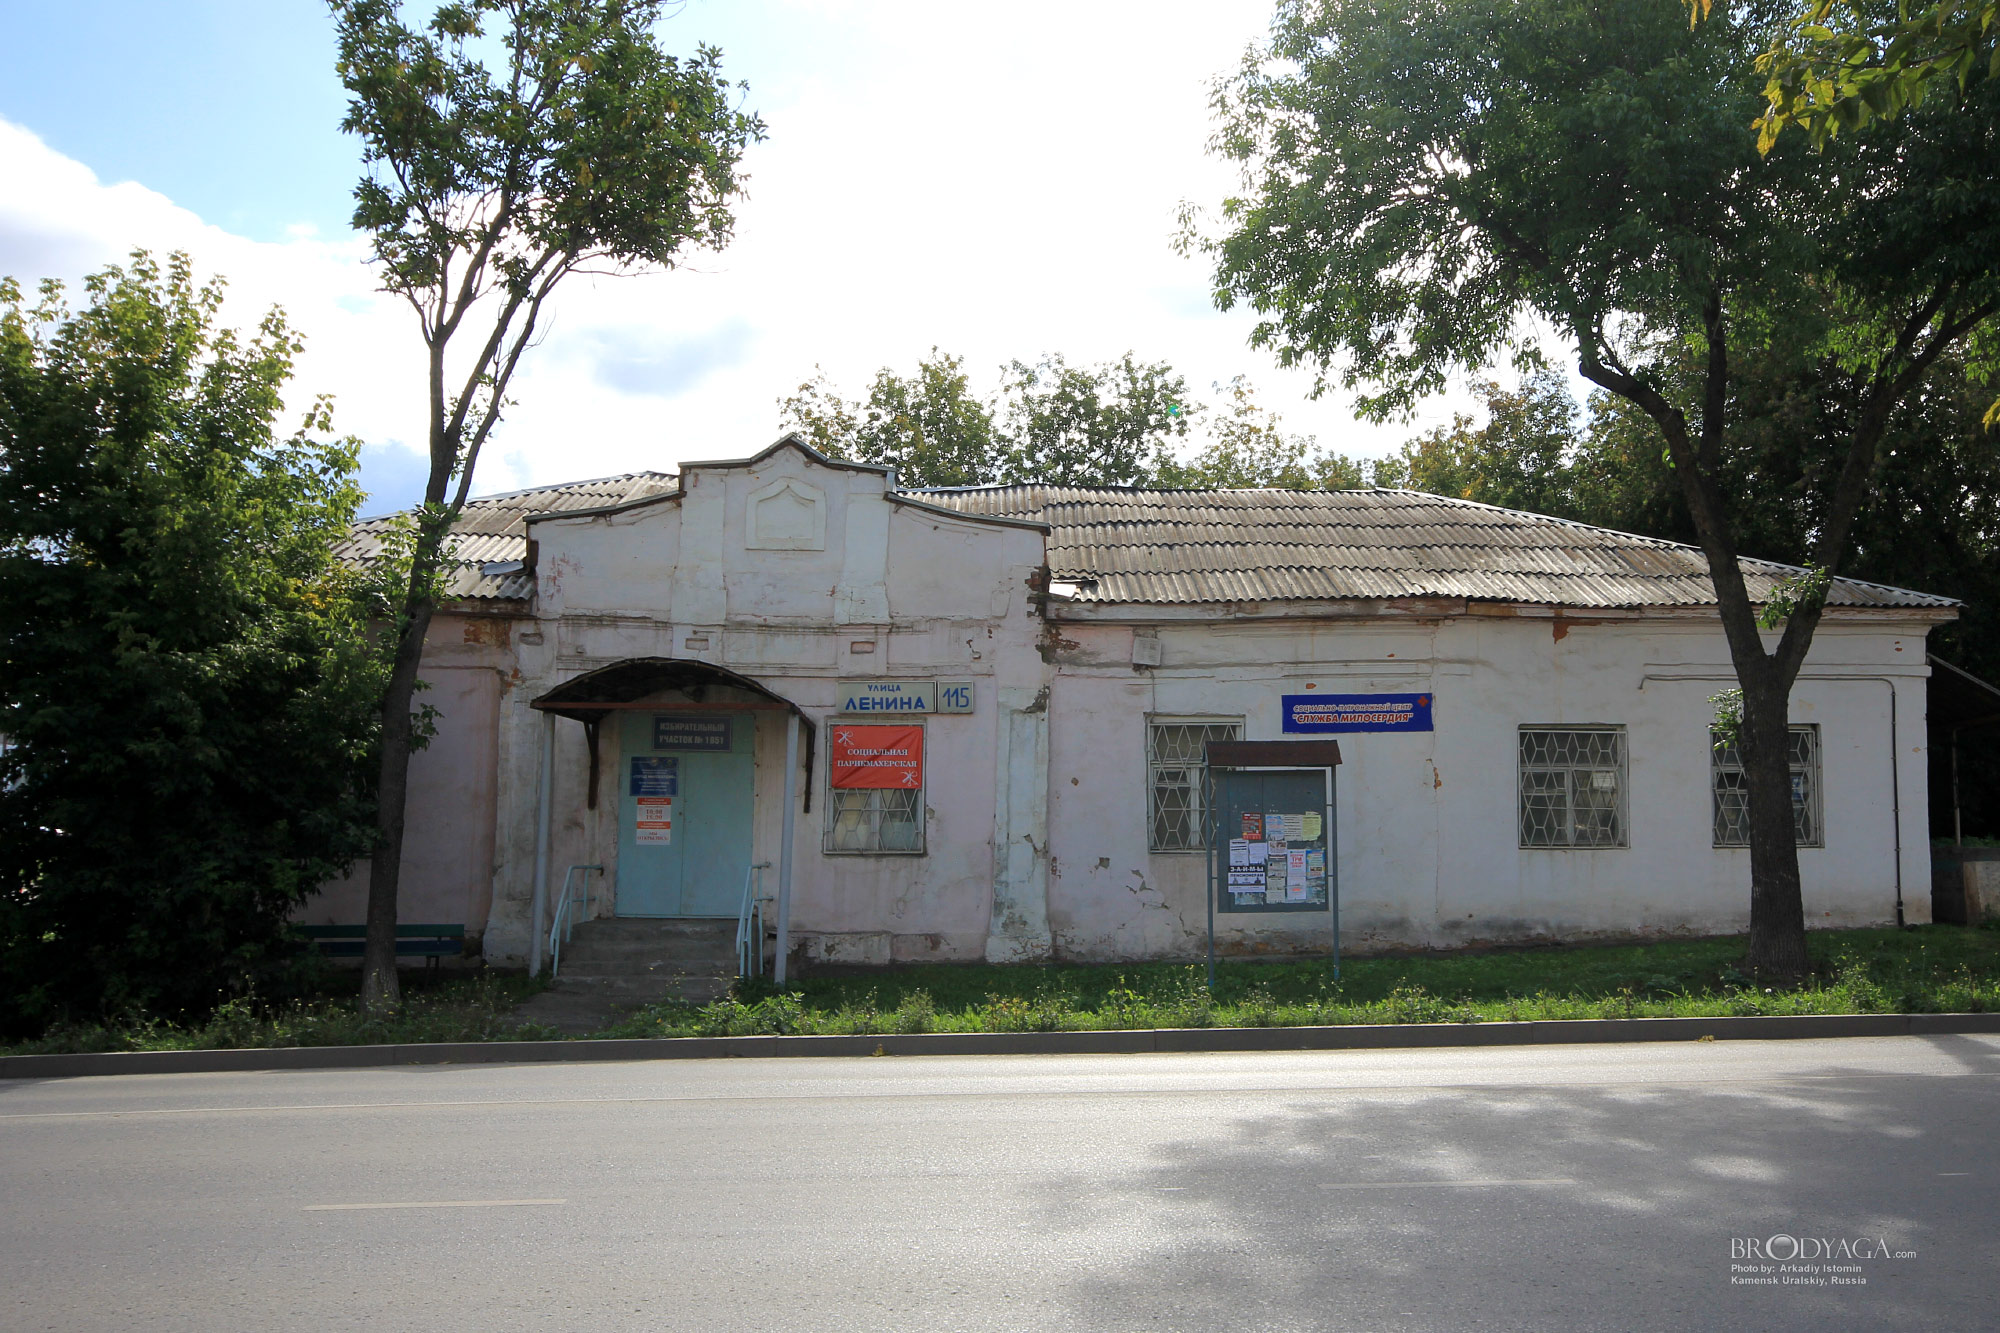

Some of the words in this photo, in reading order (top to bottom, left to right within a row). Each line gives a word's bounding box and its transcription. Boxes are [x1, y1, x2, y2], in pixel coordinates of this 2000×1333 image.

[867, 684, 902, 692] УЛИЦА
[942, 687, 970, 708] 115
[845, 696, 926, 711] ЛЕНИНА
[1392, 703, 1413, 712] ЦЕНТР
[1292, 713, 1338, 724] "СЛУЖБА
[1340, 713, 1414, 724] МИЛОСЕРДИЯ"
[660, 722, 725, 732] ИЗБИРАТЕЛЬНЫЙ
[659, 735, 693, 744] УЧАСТОК
[847, 748, 908, 757] СОЦИАЛЬНАЯ
[837, 760, 917, 768] ПАРИКМАХЕРСКАЯ
